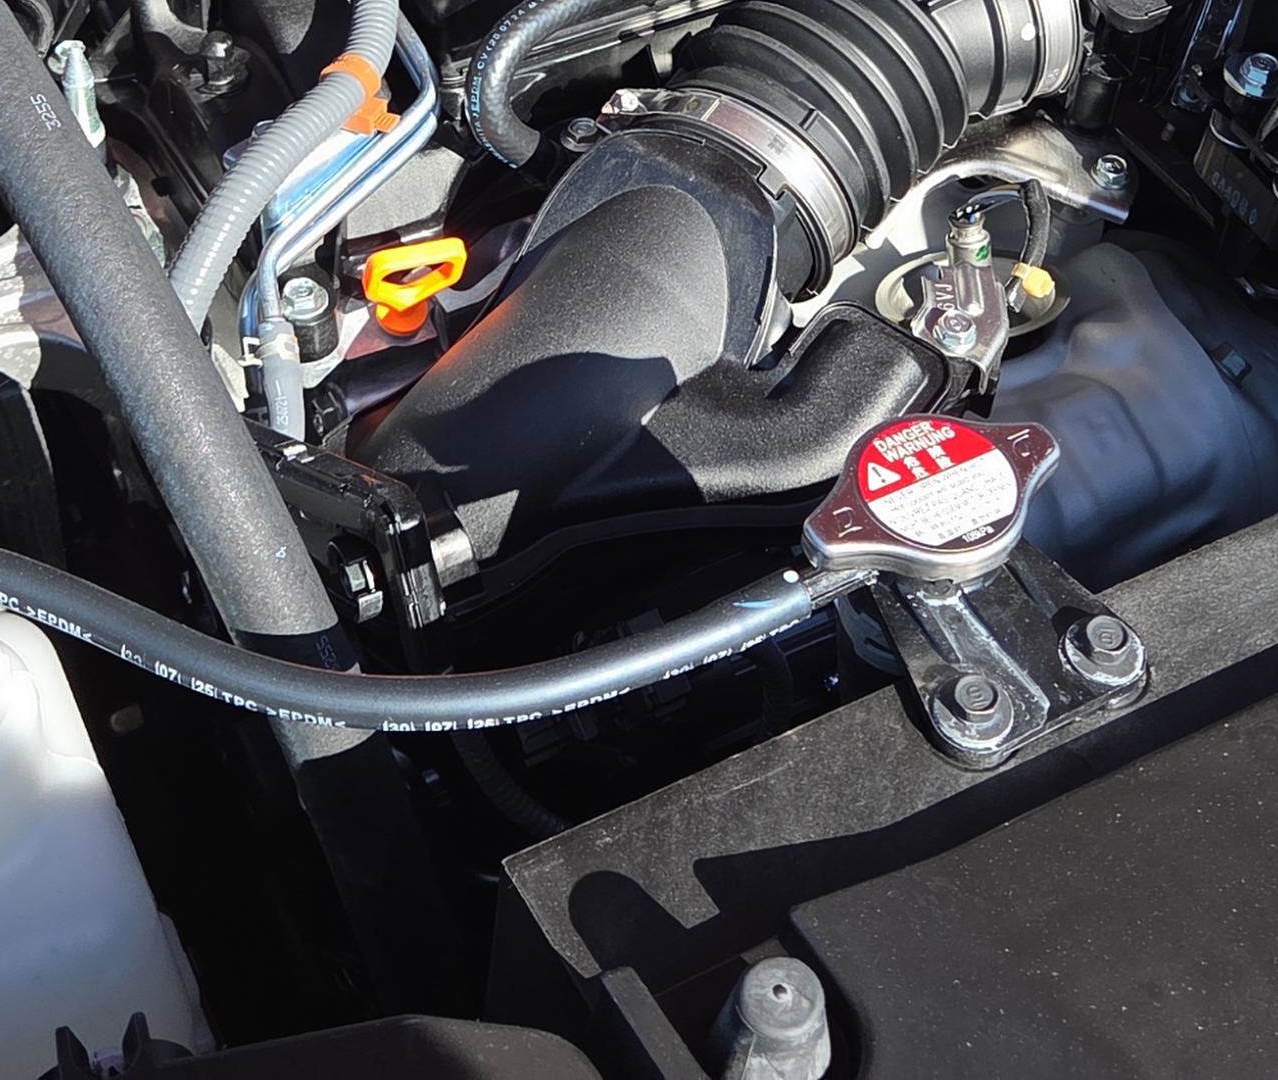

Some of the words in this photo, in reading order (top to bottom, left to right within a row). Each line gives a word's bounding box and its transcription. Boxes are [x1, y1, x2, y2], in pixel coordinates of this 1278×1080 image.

[29, 93, 61, 131] 3255
[872, 420, 935, 452] DANGER
[884, 425, 956, 463] WARNUNG
